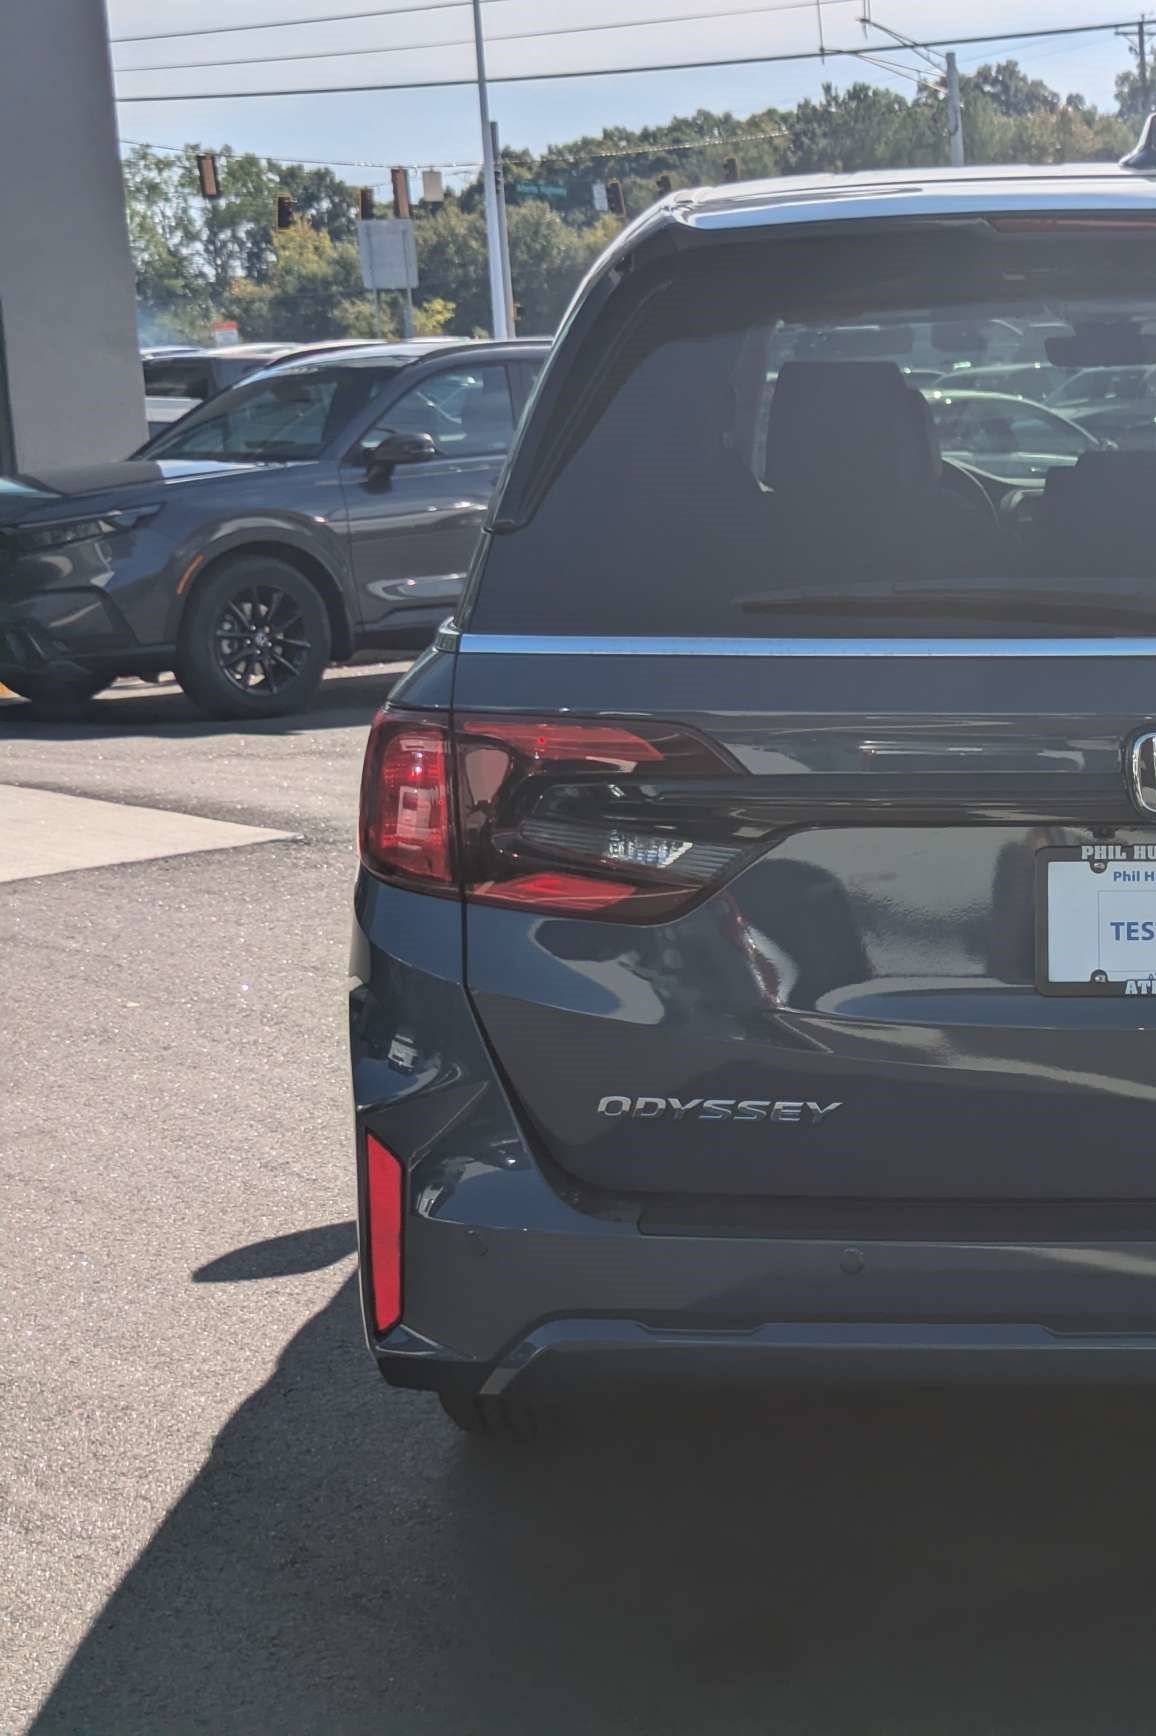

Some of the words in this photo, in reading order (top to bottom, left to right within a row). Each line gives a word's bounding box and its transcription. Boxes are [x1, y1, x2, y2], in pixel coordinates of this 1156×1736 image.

[1081, 845, 1127, 860] PHIL
[1113, 871, 1141, 882] Phil
[597, 1095, 843, 1123] ODYSSEY
